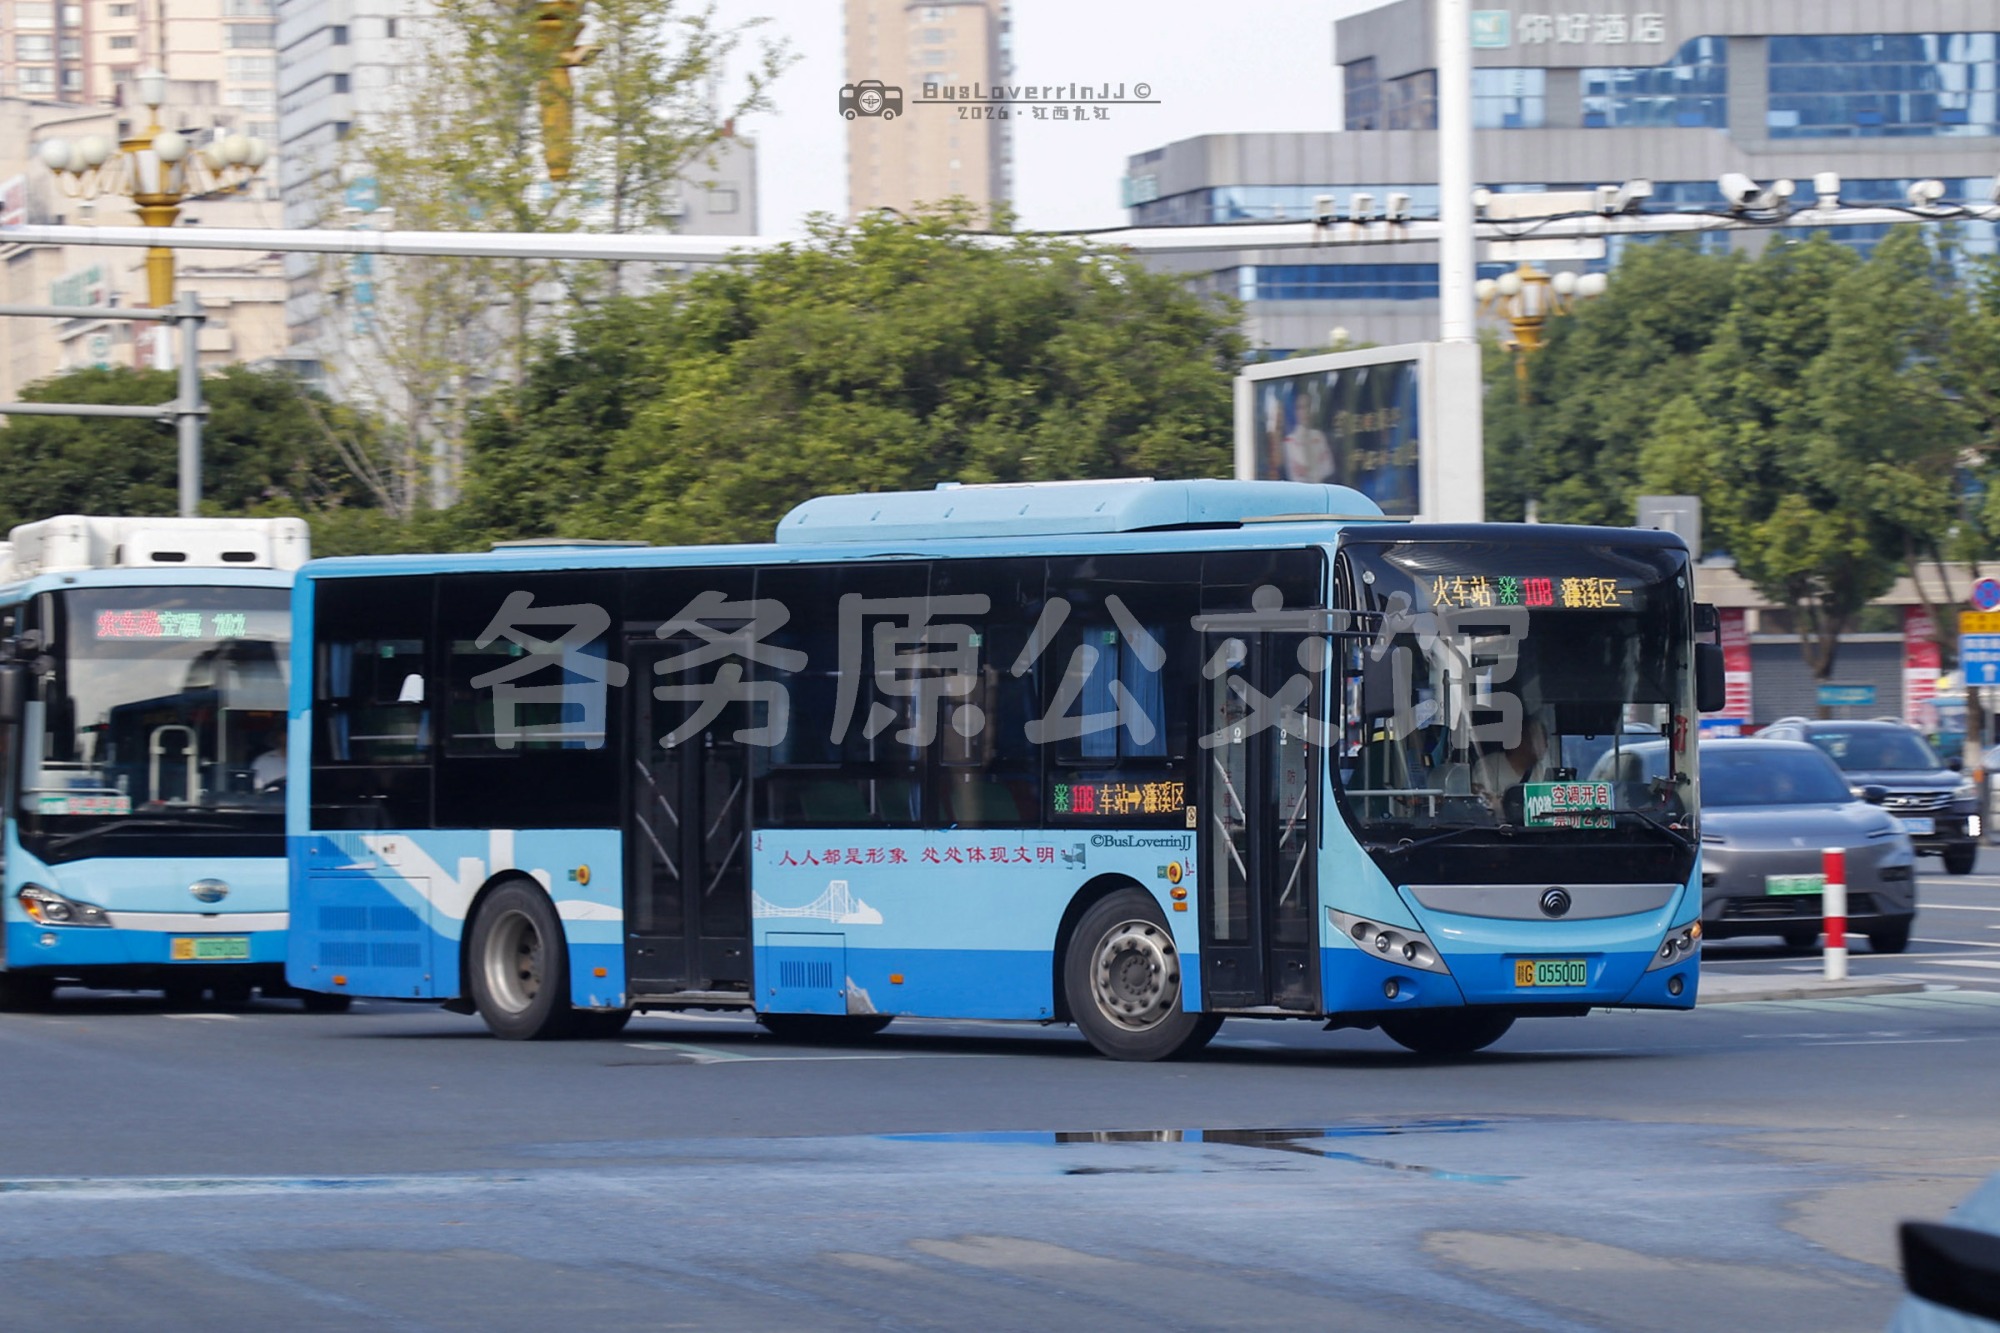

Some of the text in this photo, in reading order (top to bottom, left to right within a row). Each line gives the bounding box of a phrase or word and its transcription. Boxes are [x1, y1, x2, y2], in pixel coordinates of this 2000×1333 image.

[1517, 13, 1665, 44] 你好酒店
[1433, 575, 1492, 607] 火车站
[1522, 577, 1554, 606] 108
[1072, 785, 1095, 813] 108
[1143, 781, 1184, 813] 濂溪区
[1551, 784, 1609, 805] 空调开启
[778, 845, 1055, 867] 人人都是形象 处处体现文明
